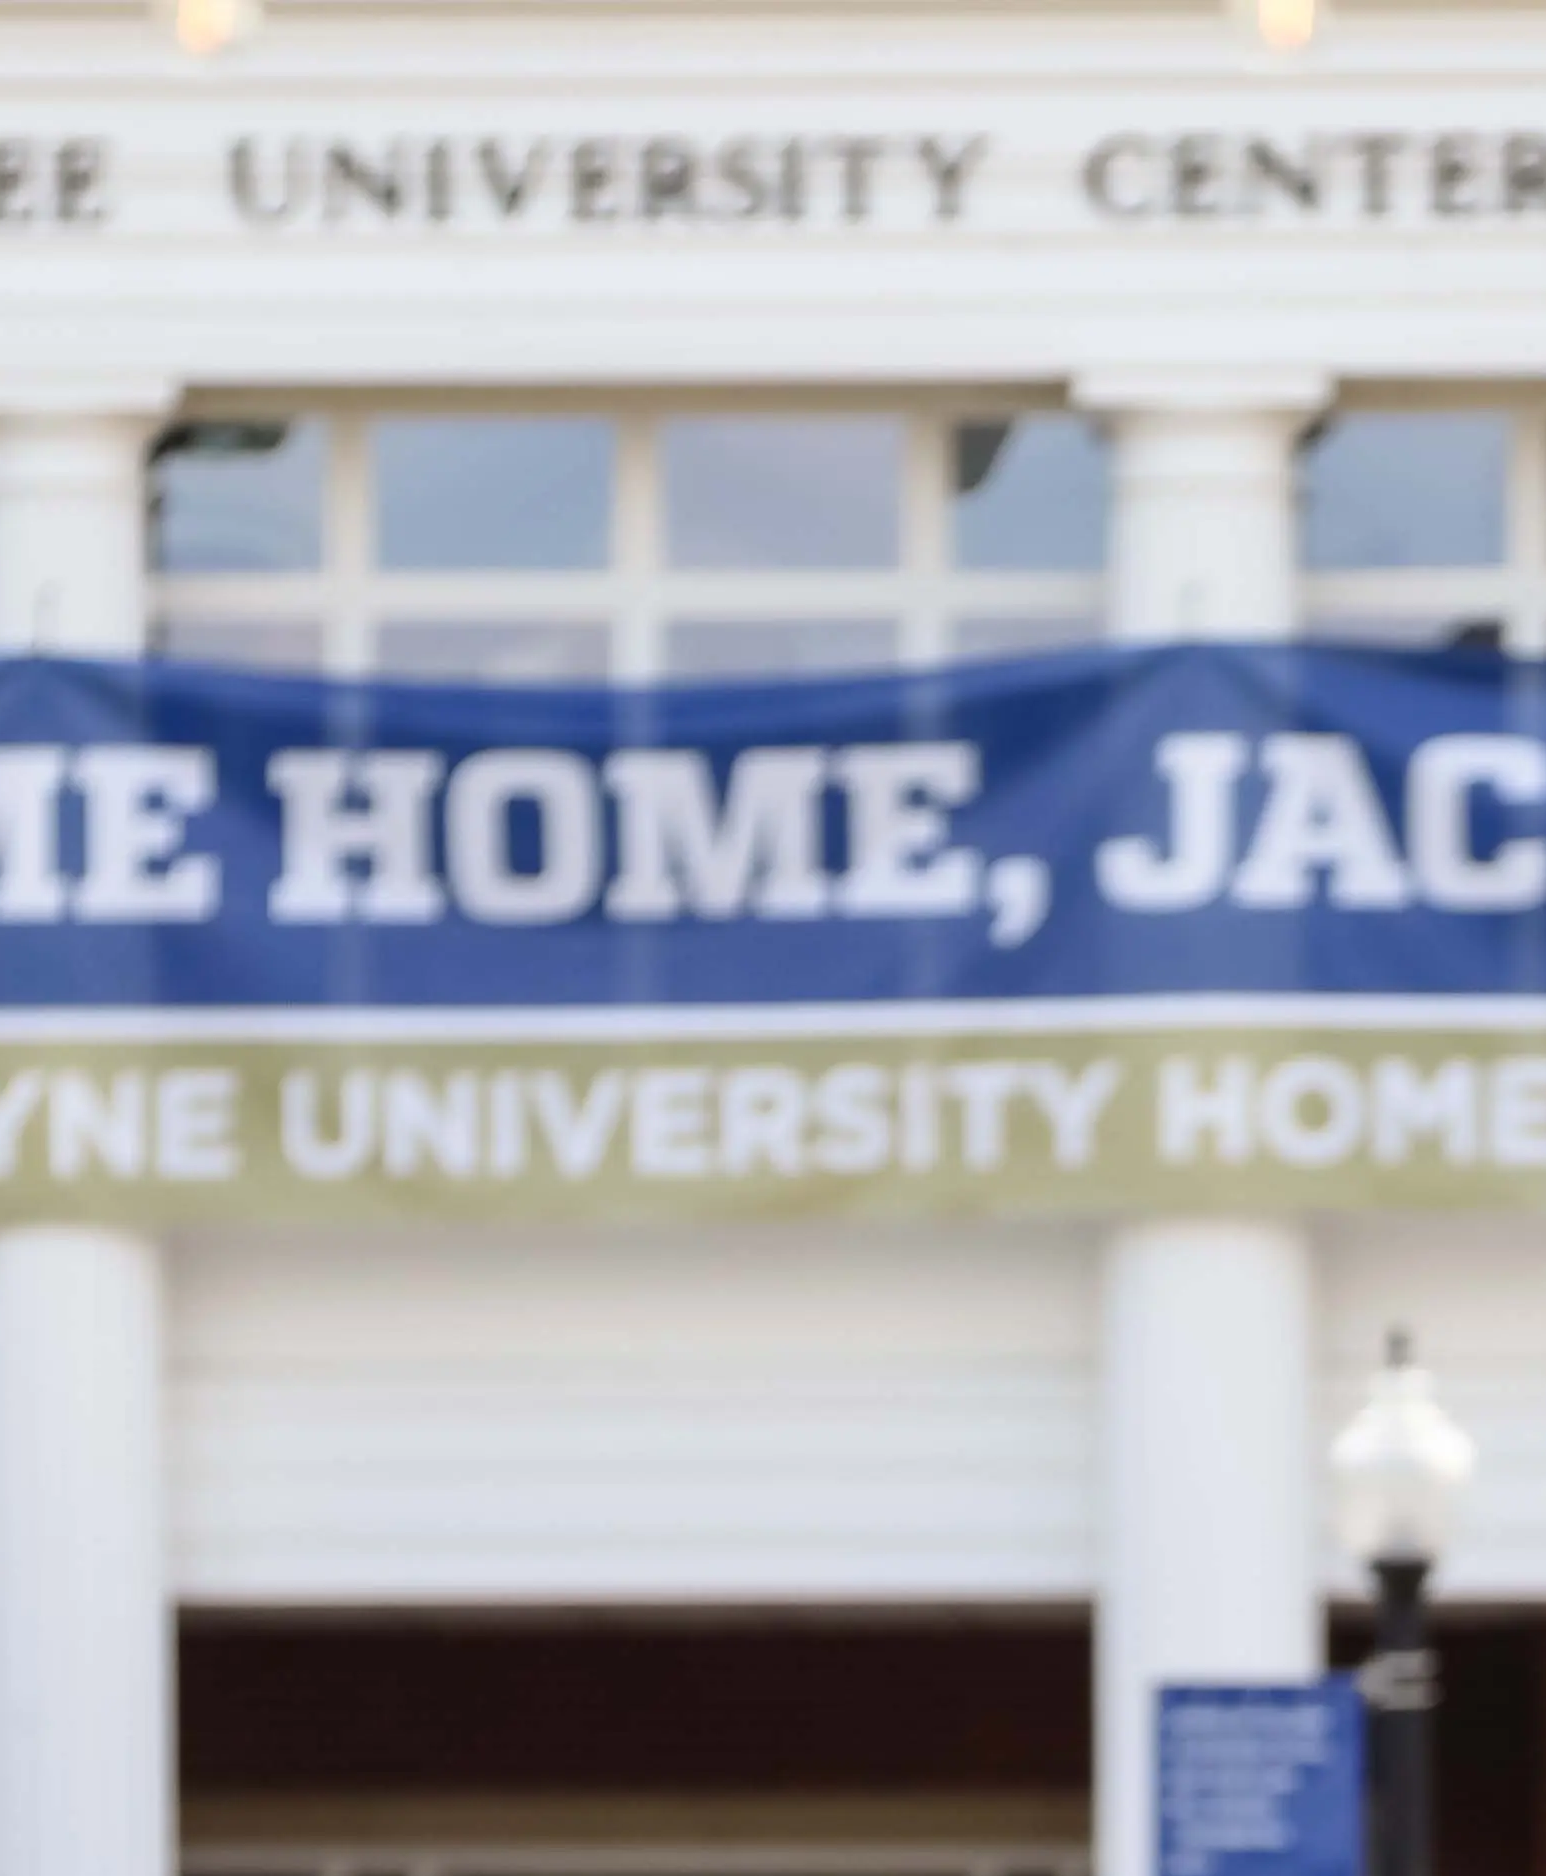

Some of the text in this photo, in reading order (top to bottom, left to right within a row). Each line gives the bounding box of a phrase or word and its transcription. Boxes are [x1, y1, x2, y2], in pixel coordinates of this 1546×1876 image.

[228, 132, 993, 228] UNIVERSITY
[266, 740, 1053, 950] HOME,
[279, 1058, 1121, 1182] UNIVERSITY
